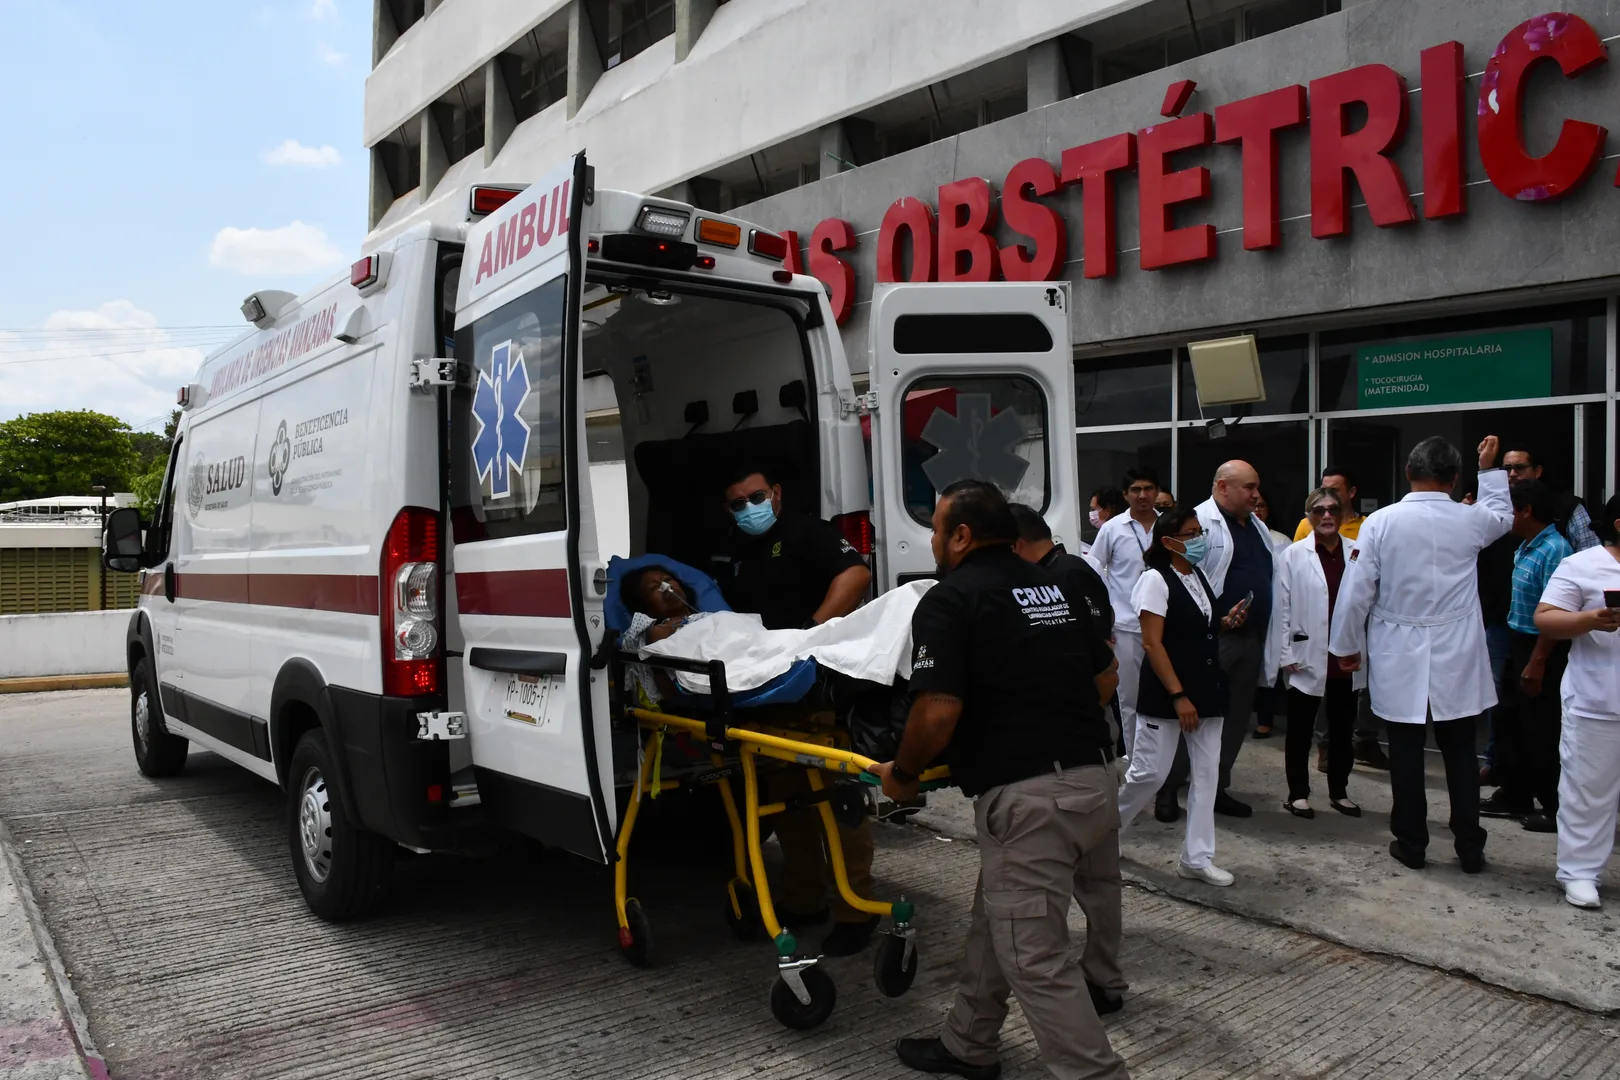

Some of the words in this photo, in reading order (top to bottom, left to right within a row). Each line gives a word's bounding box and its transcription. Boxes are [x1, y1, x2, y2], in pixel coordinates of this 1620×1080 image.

[876, 12, 1620, 282] OBSTÉTRIC
[475, 178, 570, 285] AMBUL
[287, 301, 338, 362] AVANZADAS
[1372, 351, 1421, 364] ADMISION
[1424, 344, 1502, 359] HOSPITALARIA
[1364, 383, 1430, 397] (MATERNIDAD)
[295, 408, 348, 439] BENEFICENCIA
[293, 438, 323, 459] PÚBLICA
[206, 455, 245, 495] SALUD
[1012, 584, 1066, 606] CRUM
[1040, 617, 1067, 626] YUCATÁN
